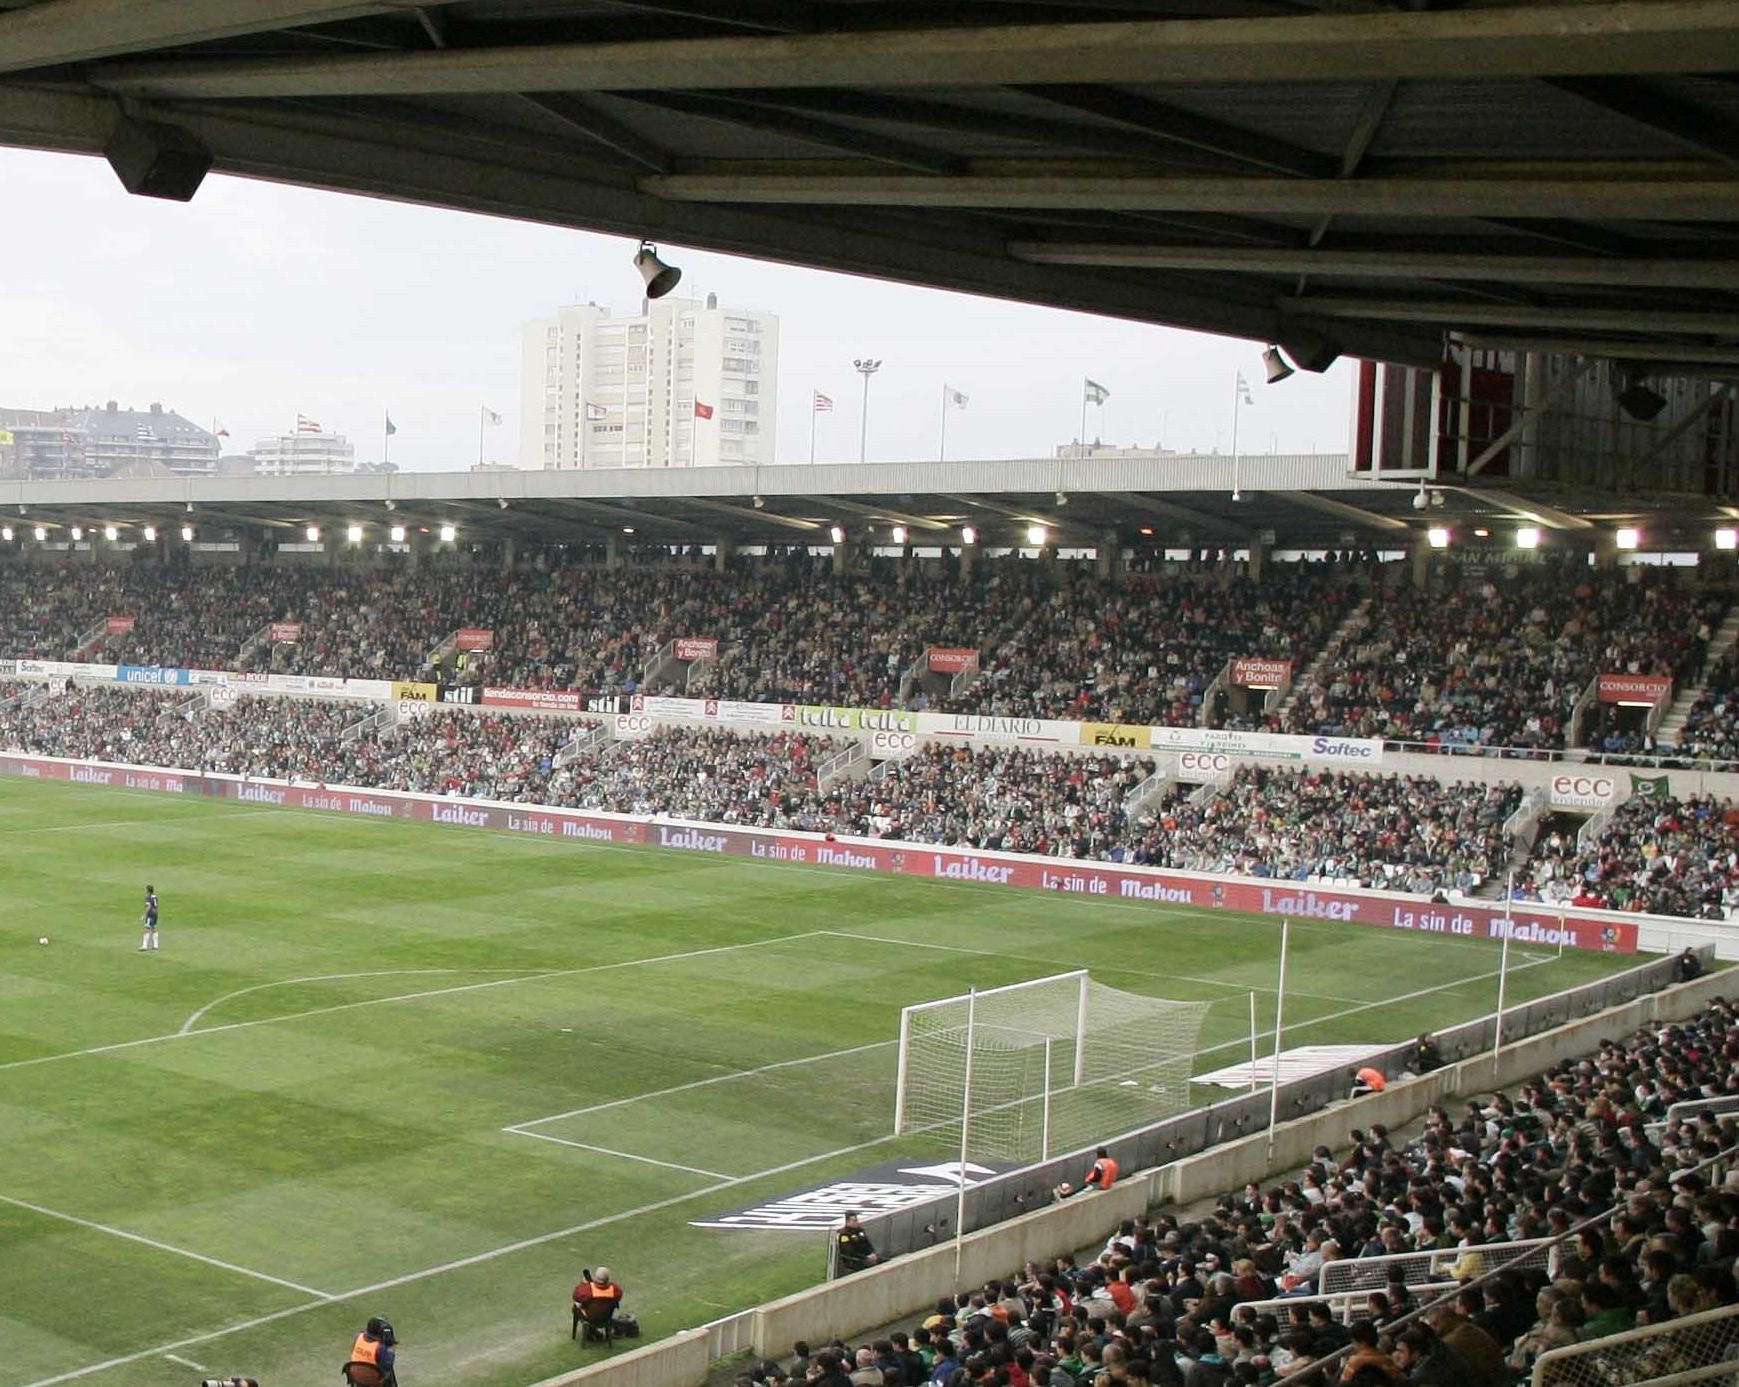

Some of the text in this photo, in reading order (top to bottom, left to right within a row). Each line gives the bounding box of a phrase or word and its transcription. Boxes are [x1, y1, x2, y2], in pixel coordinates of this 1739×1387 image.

[126, 668, 161, 683] unicef
[1235, 660, 1286, 672] Anchoas
[444, 687, 473, 703] stil
[484, 687, 579, 703] tiendaconsorcio.com
[1599, 681, 1667, 692] CONSORCIO
[588, 696, 619, 713] stil
[617, 716, 651, 731] ecc
[954, 716, 1041, 735] EL DIARIO
[875, 733, 916, 749] ecc
[1095, 735, 1135, 747] FAM
[1313, 737, 1371, 758] Softec
[1182, 753, 1228, 771] ecc
[237, 783, 286, 803] Laiker
[1554, 776, 1611, 796] ecc
[350, 798, 392, 816] Mahou
[432, 803, 488, 826] Laiker
[508, 814, 612, 841] La sin de Mahou
[660, 826, 727, 852] Laiker
[752, 840, 877, 870] La sin de Mahou
[934, 854, 1014, 884] Laiker
[1043, 871, 1191, 903] La sin de Mahou
[1262, 888, 1360, 921] Laiker
[1394, 907, 1577, 946] La sin de Mahou
